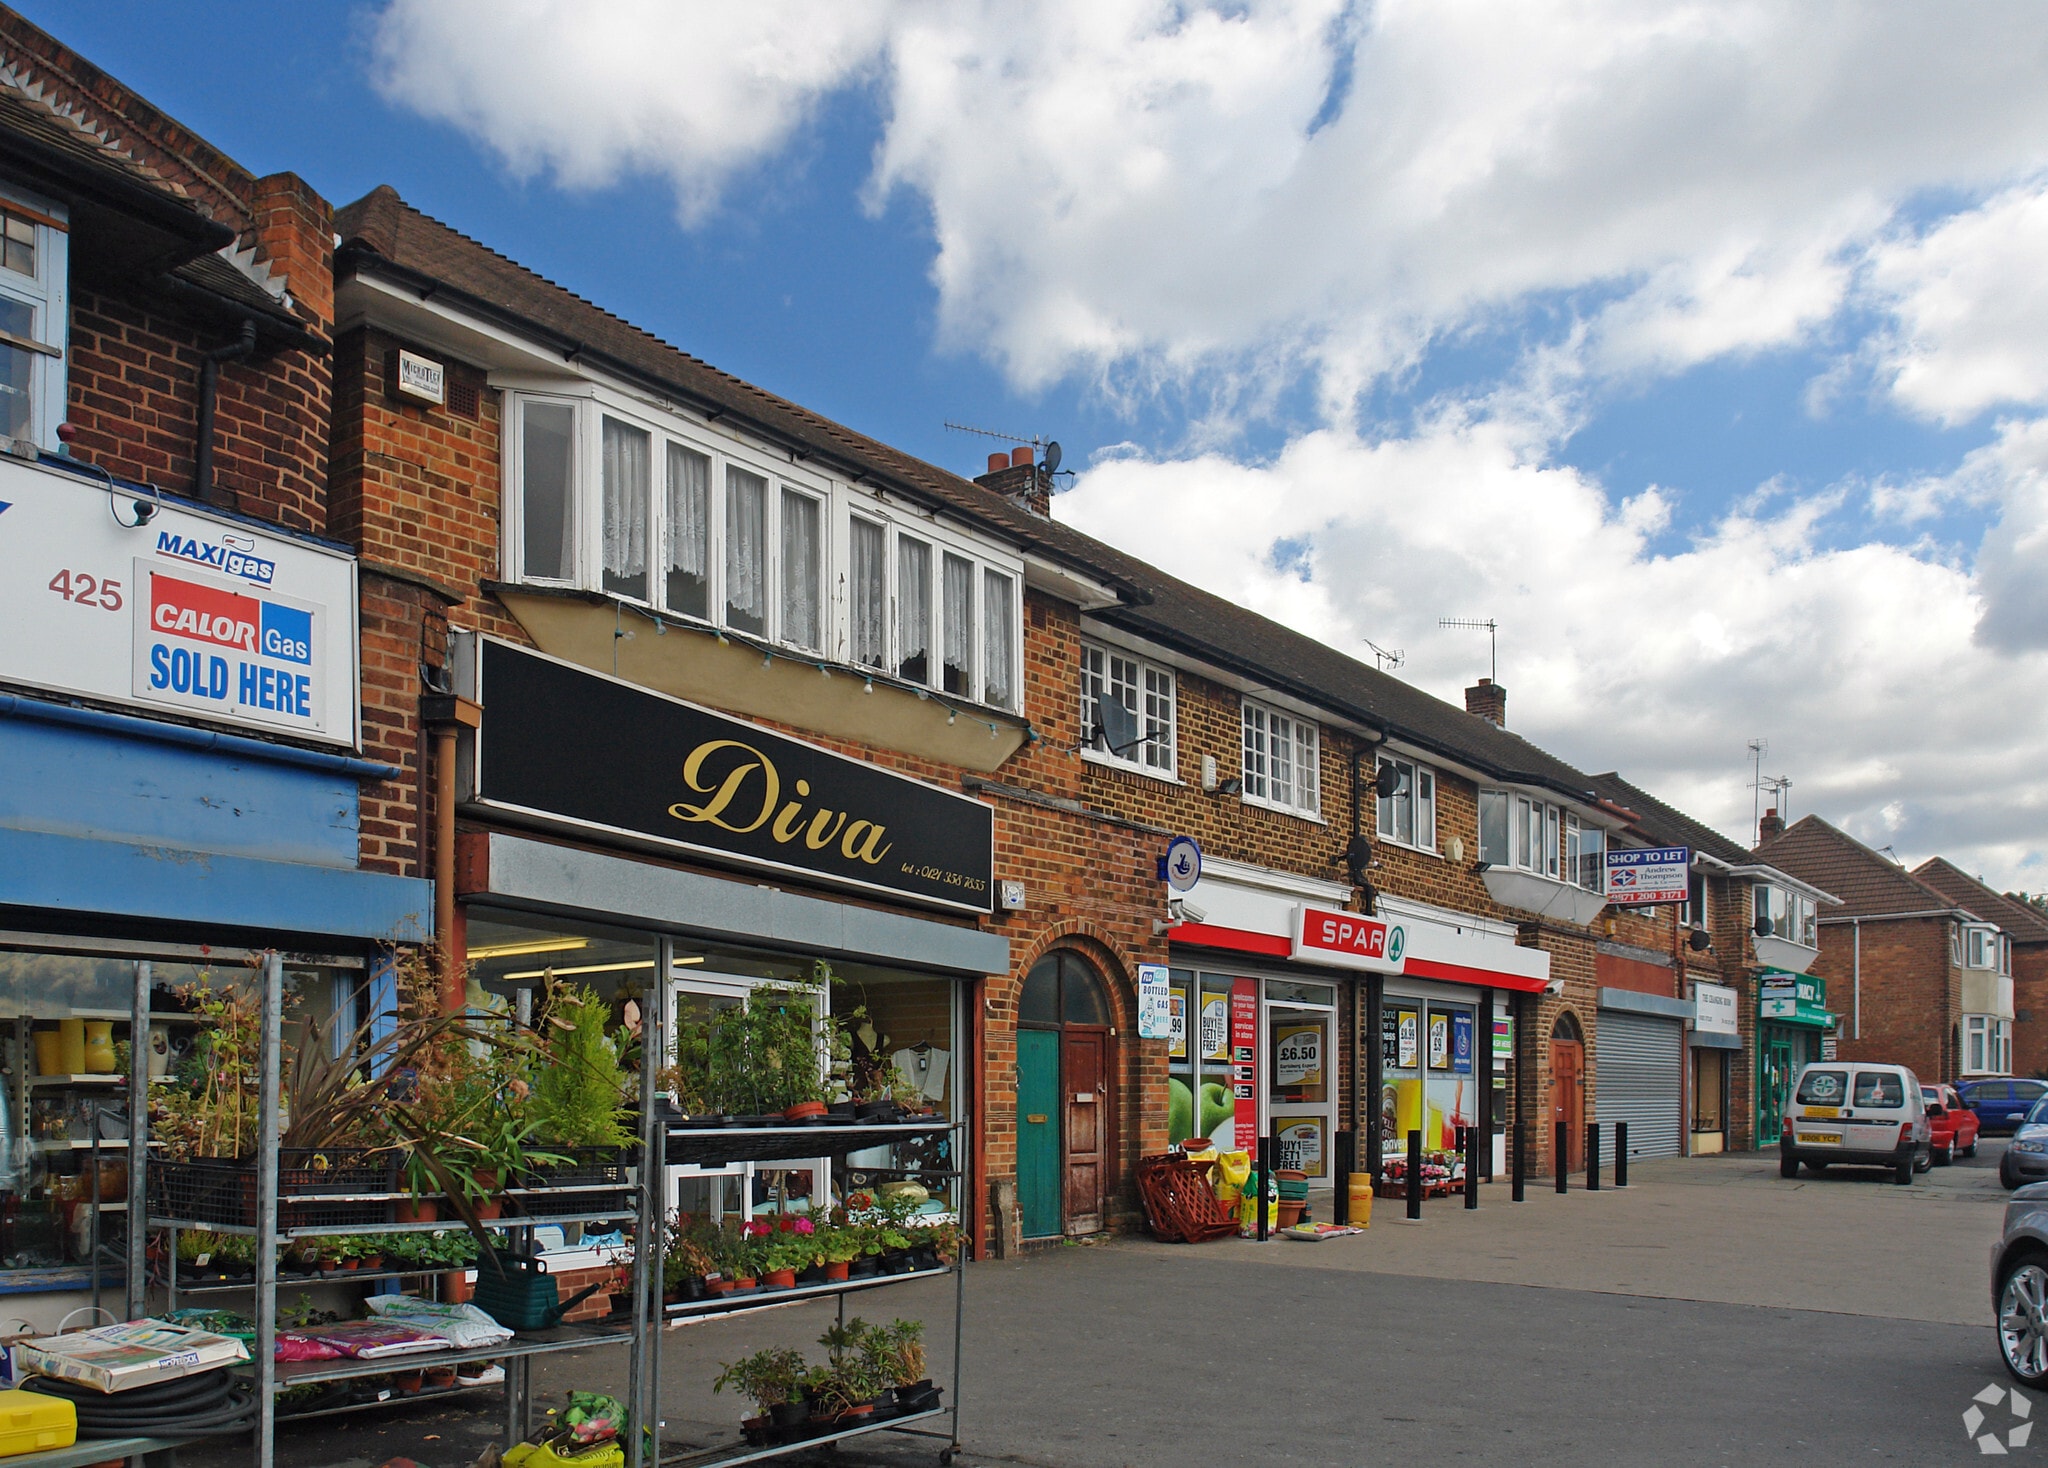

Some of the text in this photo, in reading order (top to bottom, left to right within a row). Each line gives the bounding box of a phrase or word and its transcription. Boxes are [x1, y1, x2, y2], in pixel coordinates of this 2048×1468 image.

[48, 568, 123, 612] 425
[154, 603, 308, 660] CALOR Gas
[150, 643, 312, 718] SOLD HERE
[667, 739, 893, 865] Diva
[1608, 850, 1683, 864] SHOP TO LET
[921, 865, 943, 881] 0121
[943, 871, 963, 887] 358
[963, 876, 987, 892] 7855
[1640, 872, 1683, 880] Thompson
[1637, 892, 1657, 900] 200
[1660, 891, 1682, 899] 3171
[1322, 919, 1384, 952] SPAR
[1143, 986, 1168, 996] BOTTLED
[1157, 1000, 1168, 1009] GAS
[1203, 1039, 1217, 1051] FREE
[1280, 1046, 1316, 1061] £6.50
